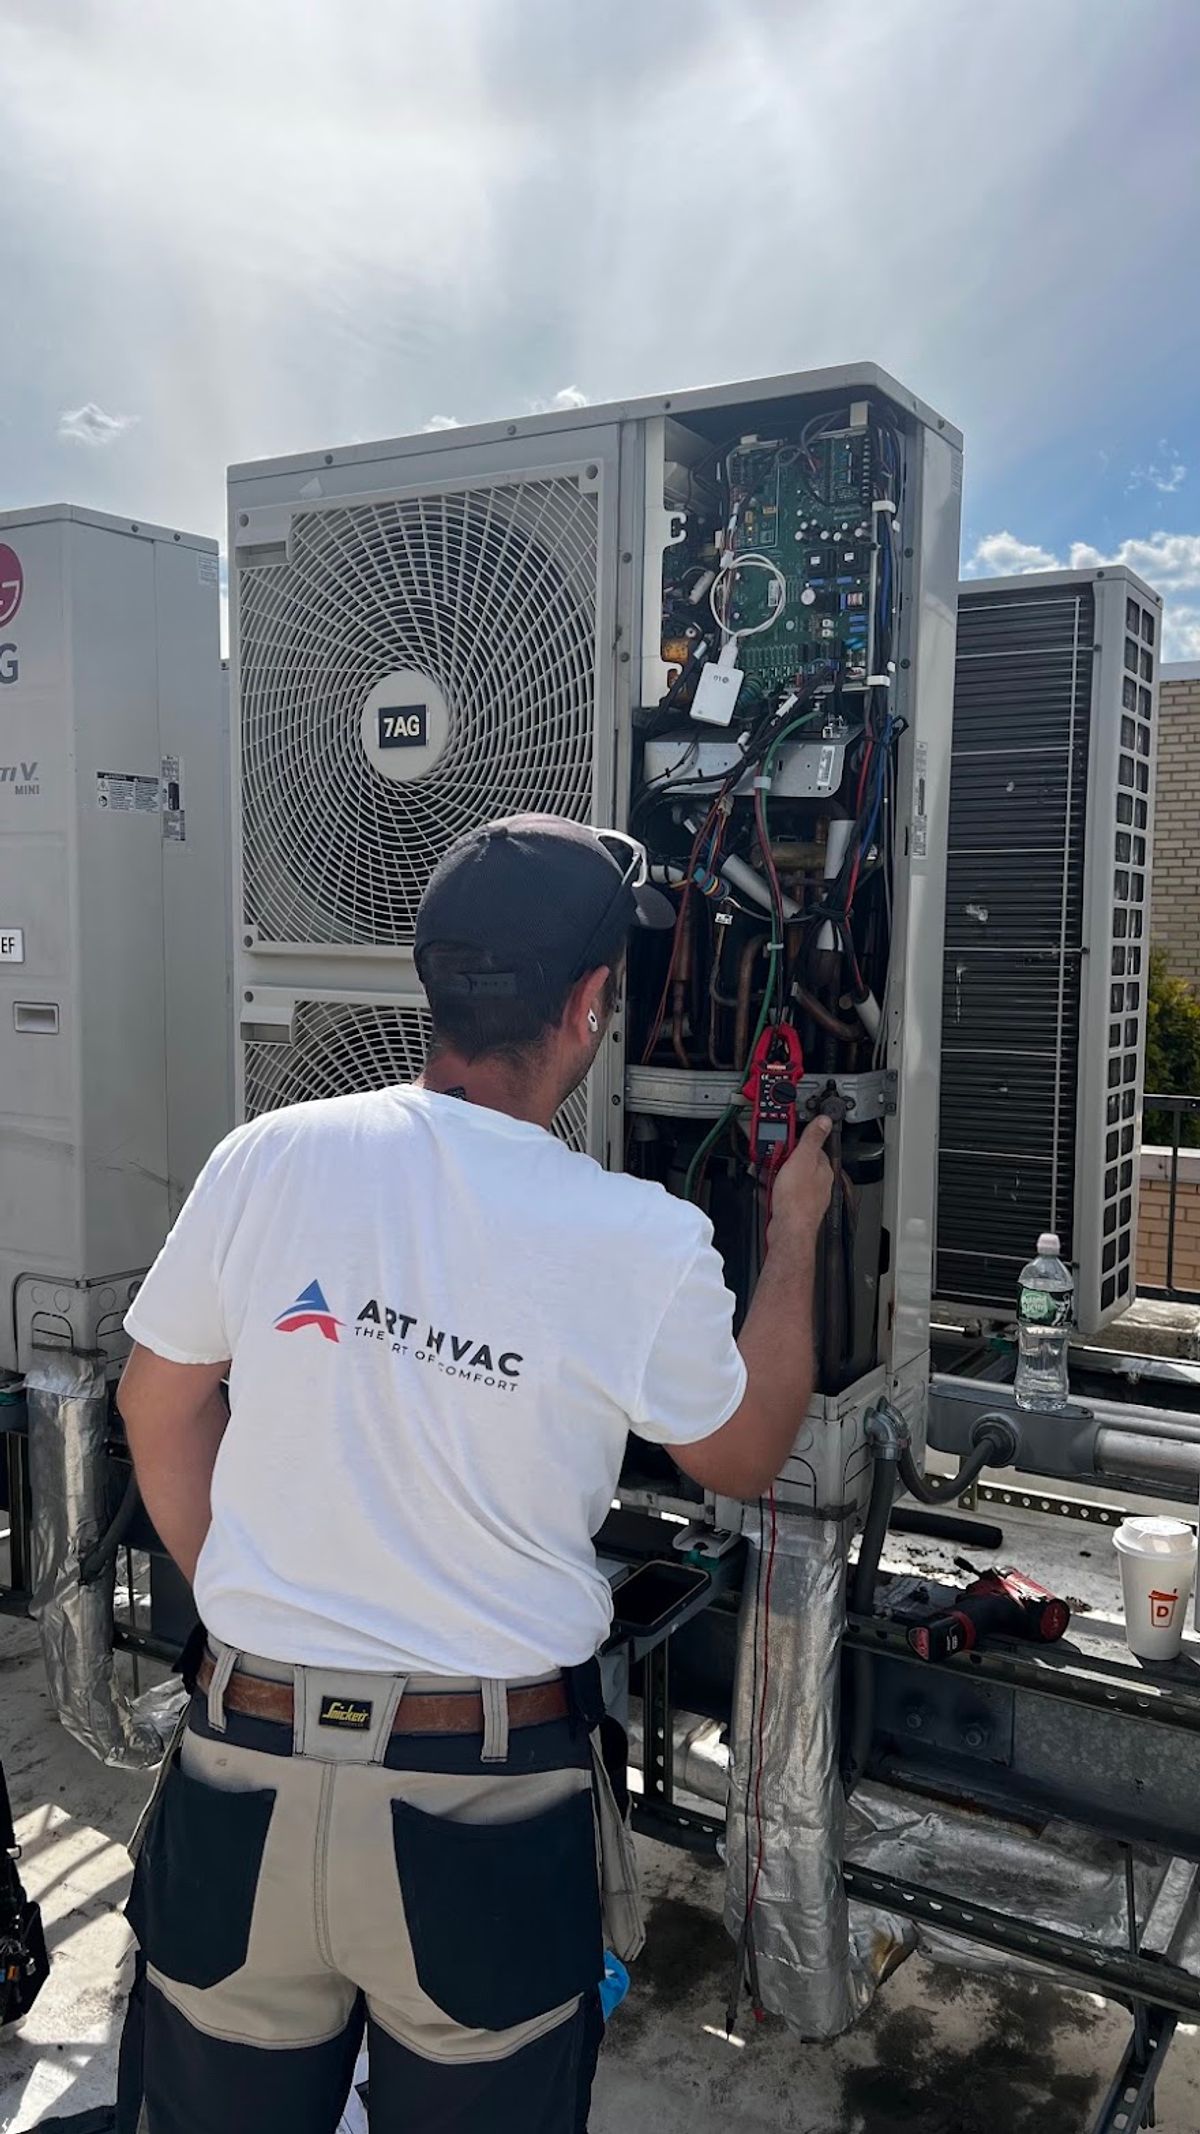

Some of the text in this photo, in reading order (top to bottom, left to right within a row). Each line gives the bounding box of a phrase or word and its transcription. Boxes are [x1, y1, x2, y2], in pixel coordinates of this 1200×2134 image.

[383, 715, 420, 738] 7AG
[15, 785, 40, 795] MINI
[355, 1326, 385, 1341] THE
[391, 1343, 408, 1356] RT
[415, 1350, 436, 1363] OF
[357, 1299, 524, 1377] ART HVAC
[1157, 1606, 1169, 1617] D
[321, 1702, 369, 1722] Snickers
